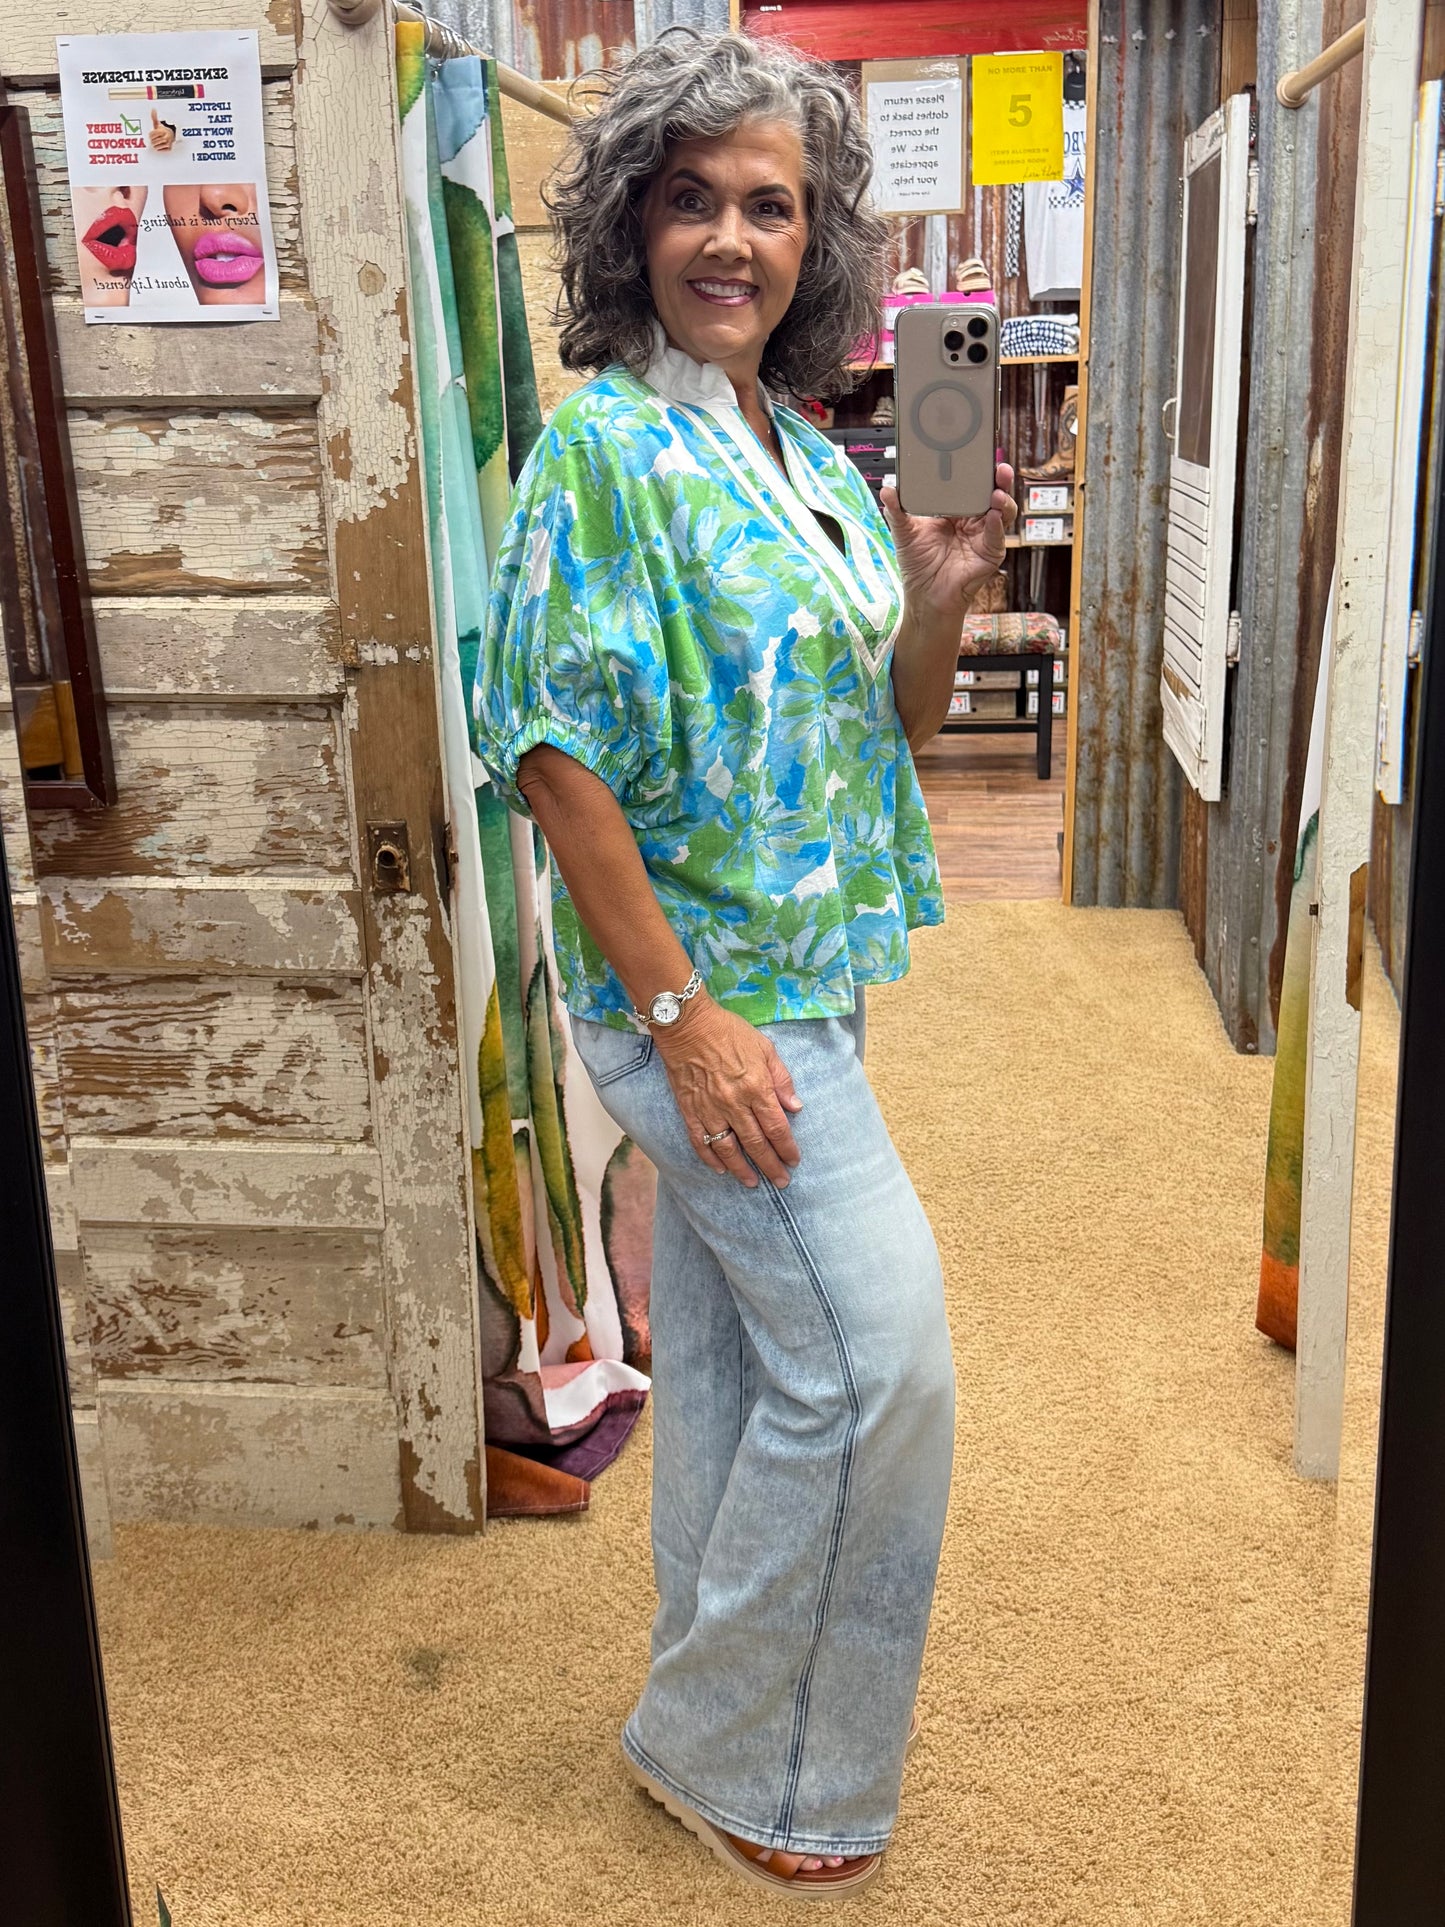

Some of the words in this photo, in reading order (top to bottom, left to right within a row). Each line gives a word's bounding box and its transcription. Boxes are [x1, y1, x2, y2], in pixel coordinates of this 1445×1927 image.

[988, 67, 1001, 75] NO
[1002, 66, 1026, 74] MORE
[1029, 65, 1053, 73] THAN
[1008, 94, 1033, 128] 5
